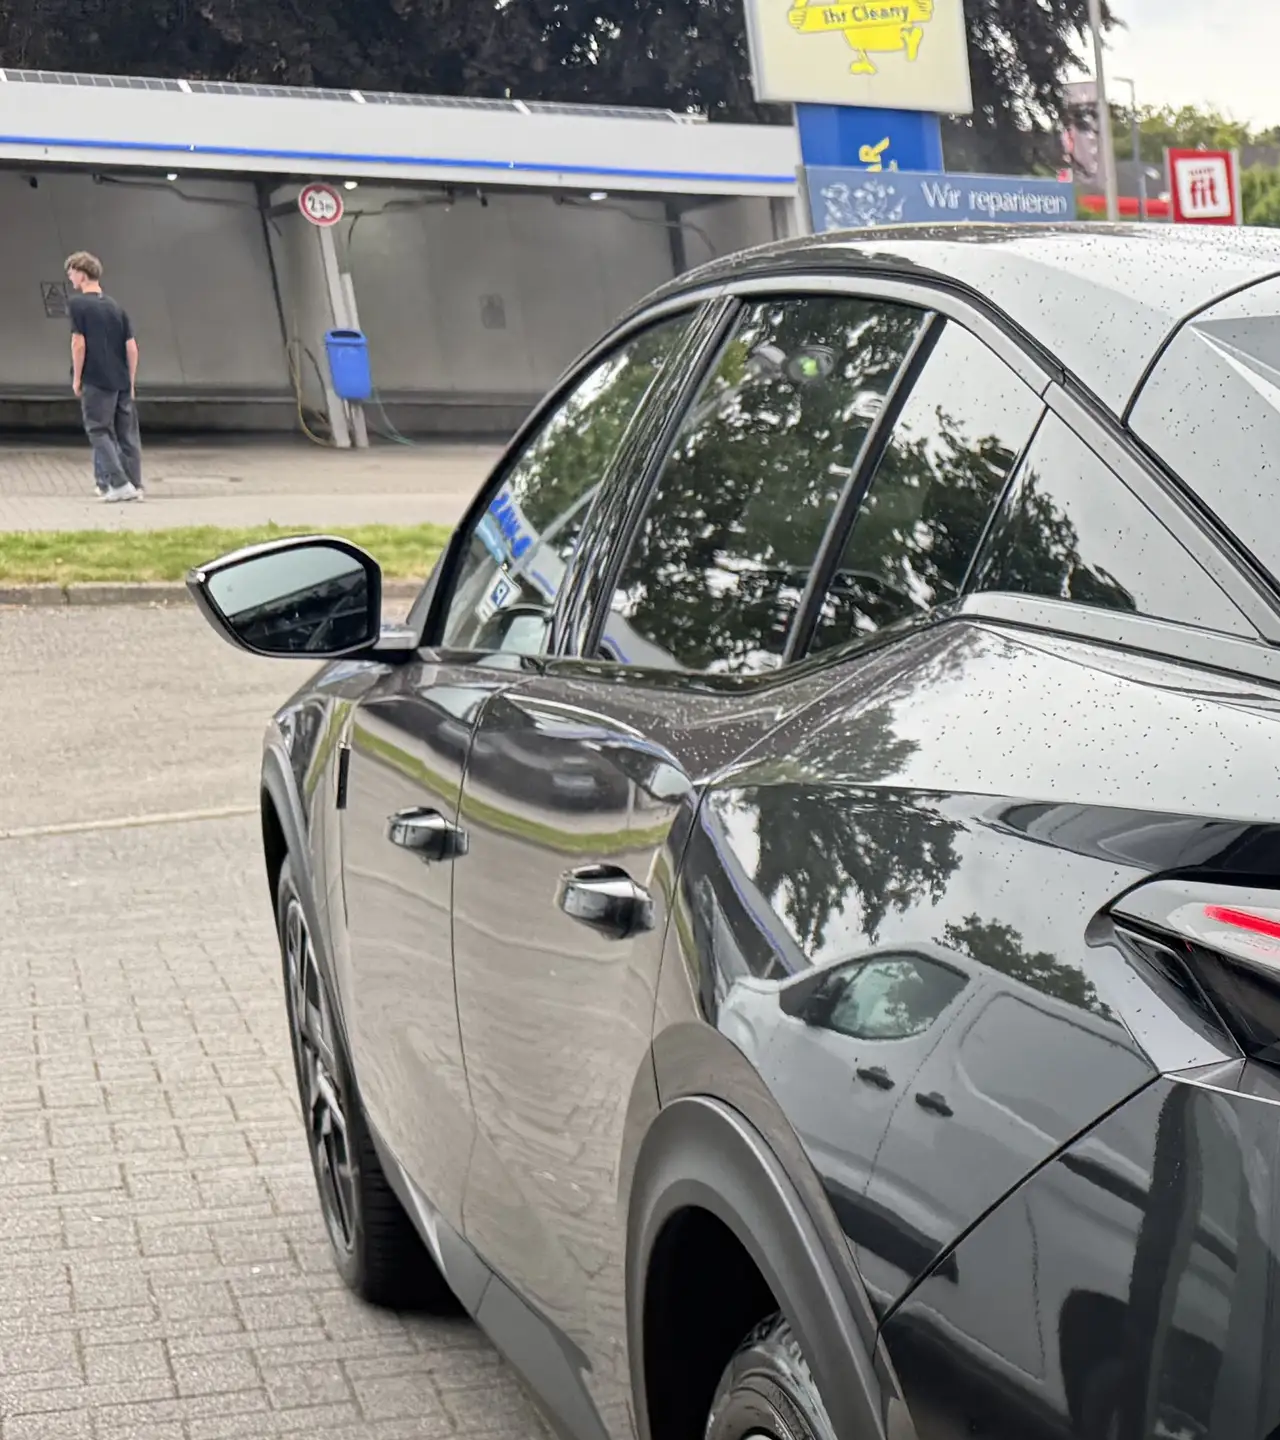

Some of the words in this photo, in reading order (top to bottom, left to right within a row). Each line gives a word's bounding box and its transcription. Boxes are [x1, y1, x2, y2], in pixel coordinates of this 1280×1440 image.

[920, 181, 962, 209] Wir
[969, 187, 1068, 218] reparieren
[1190, 177, 1219, 209] fit
